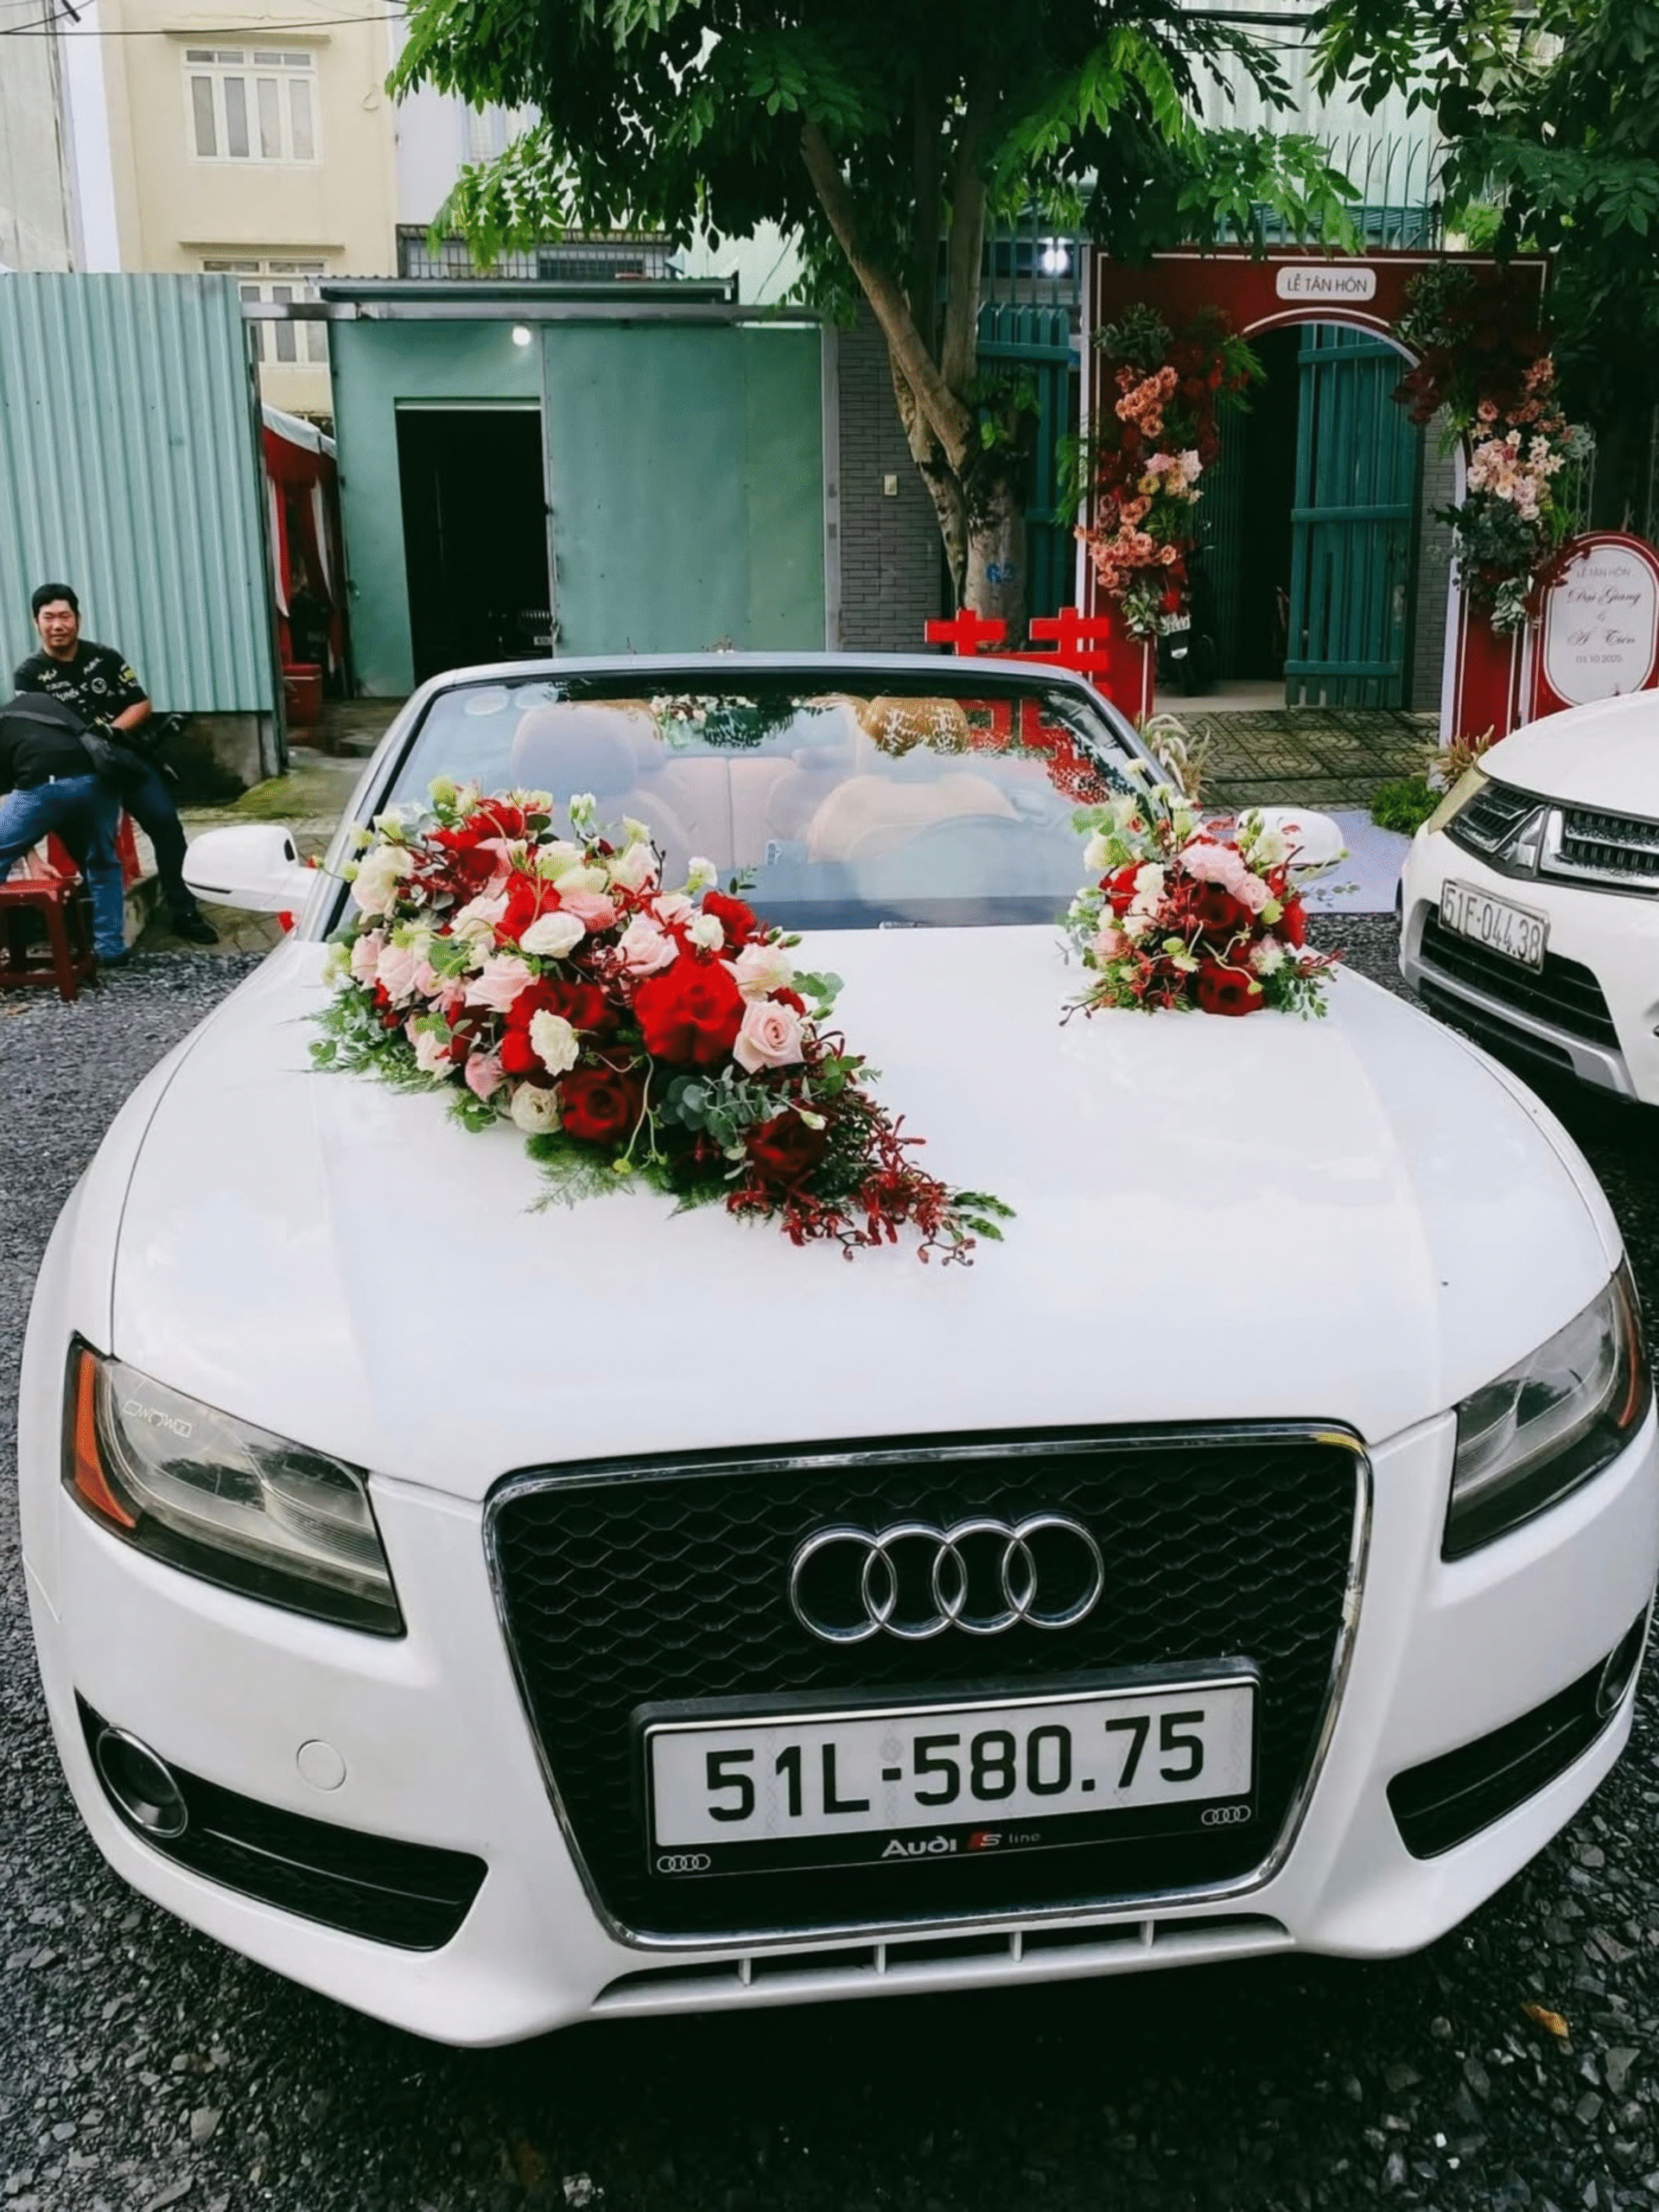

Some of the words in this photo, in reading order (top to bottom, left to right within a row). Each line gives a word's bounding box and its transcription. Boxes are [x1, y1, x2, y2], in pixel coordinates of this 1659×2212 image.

[1306, 276, 1332, 292] TÂN
[1336, 276, 1367, 293] HÔN
[1444, 887, 1541, 964] 51F-044.38
[706, 1709, 1205, 1822] 51L-580.75
[880, 1834, 957, 1859] Audi
[1008, 1832, 1042, 1845] line
